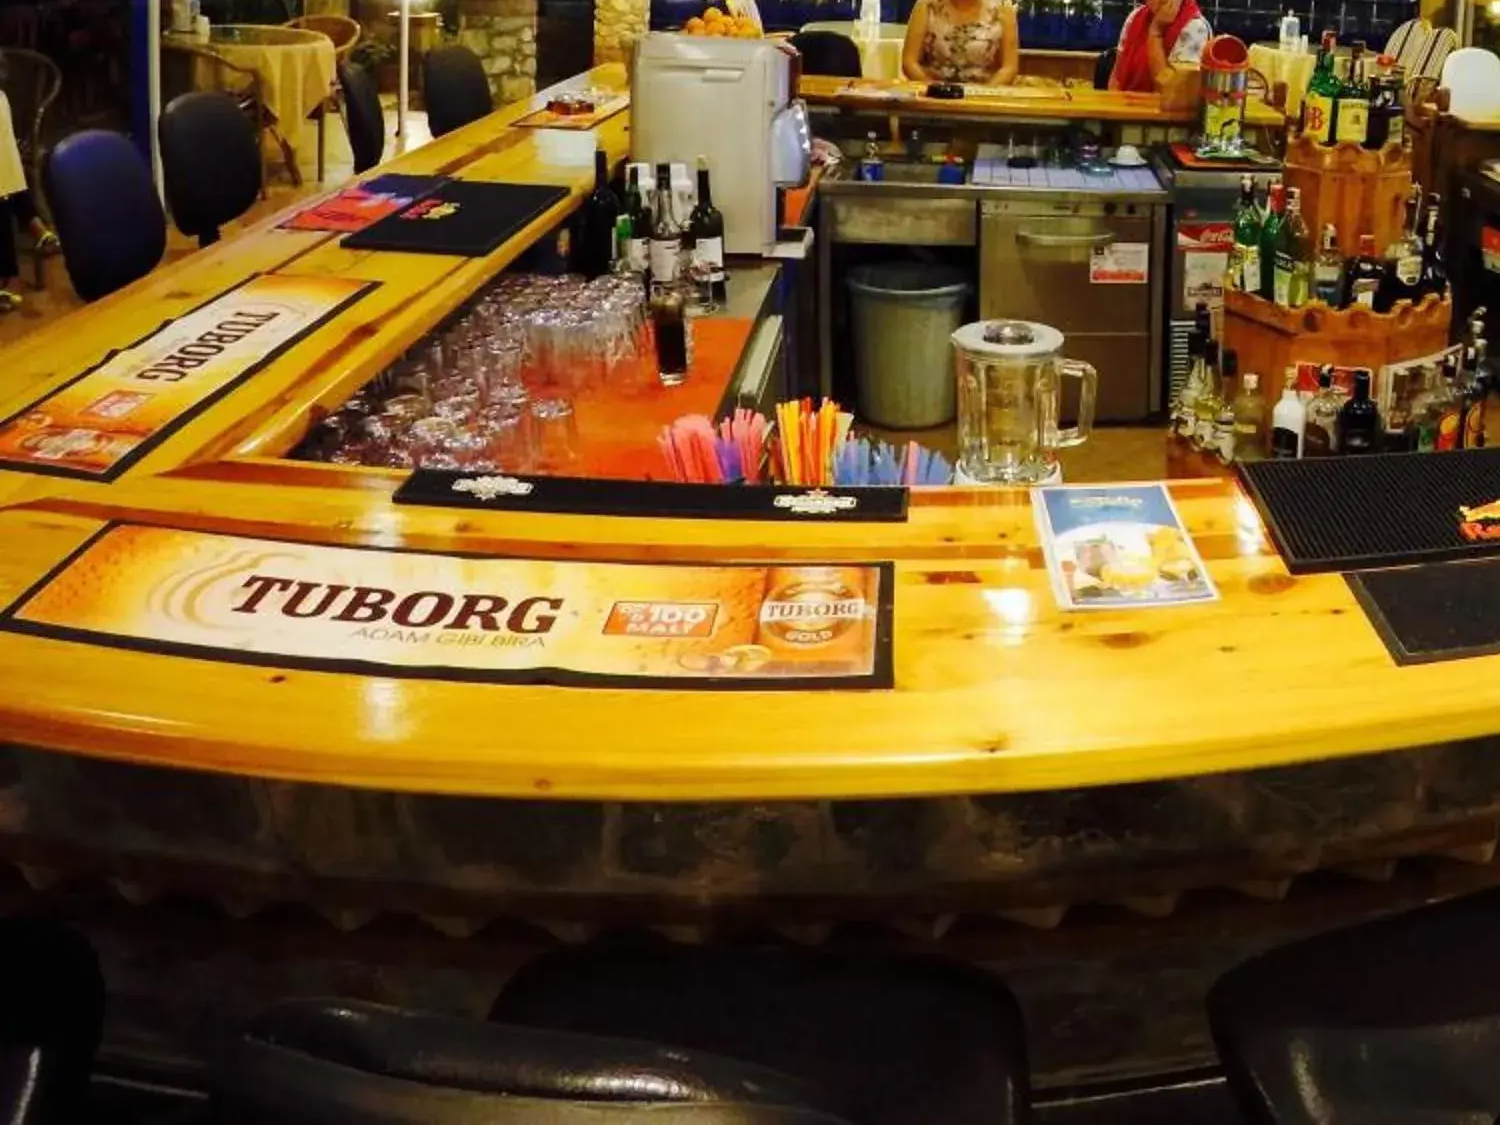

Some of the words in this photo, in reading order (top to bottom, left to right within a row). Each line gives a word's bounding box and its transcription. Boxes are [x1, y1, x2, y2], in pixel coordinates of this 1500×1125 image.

[136, 311, 281, 383] TUBORG
[231, 574, 565, 634] TUBORG
[767, 602, 858, 618] TUBORG
[785, 630, 832, 643] GOLD
